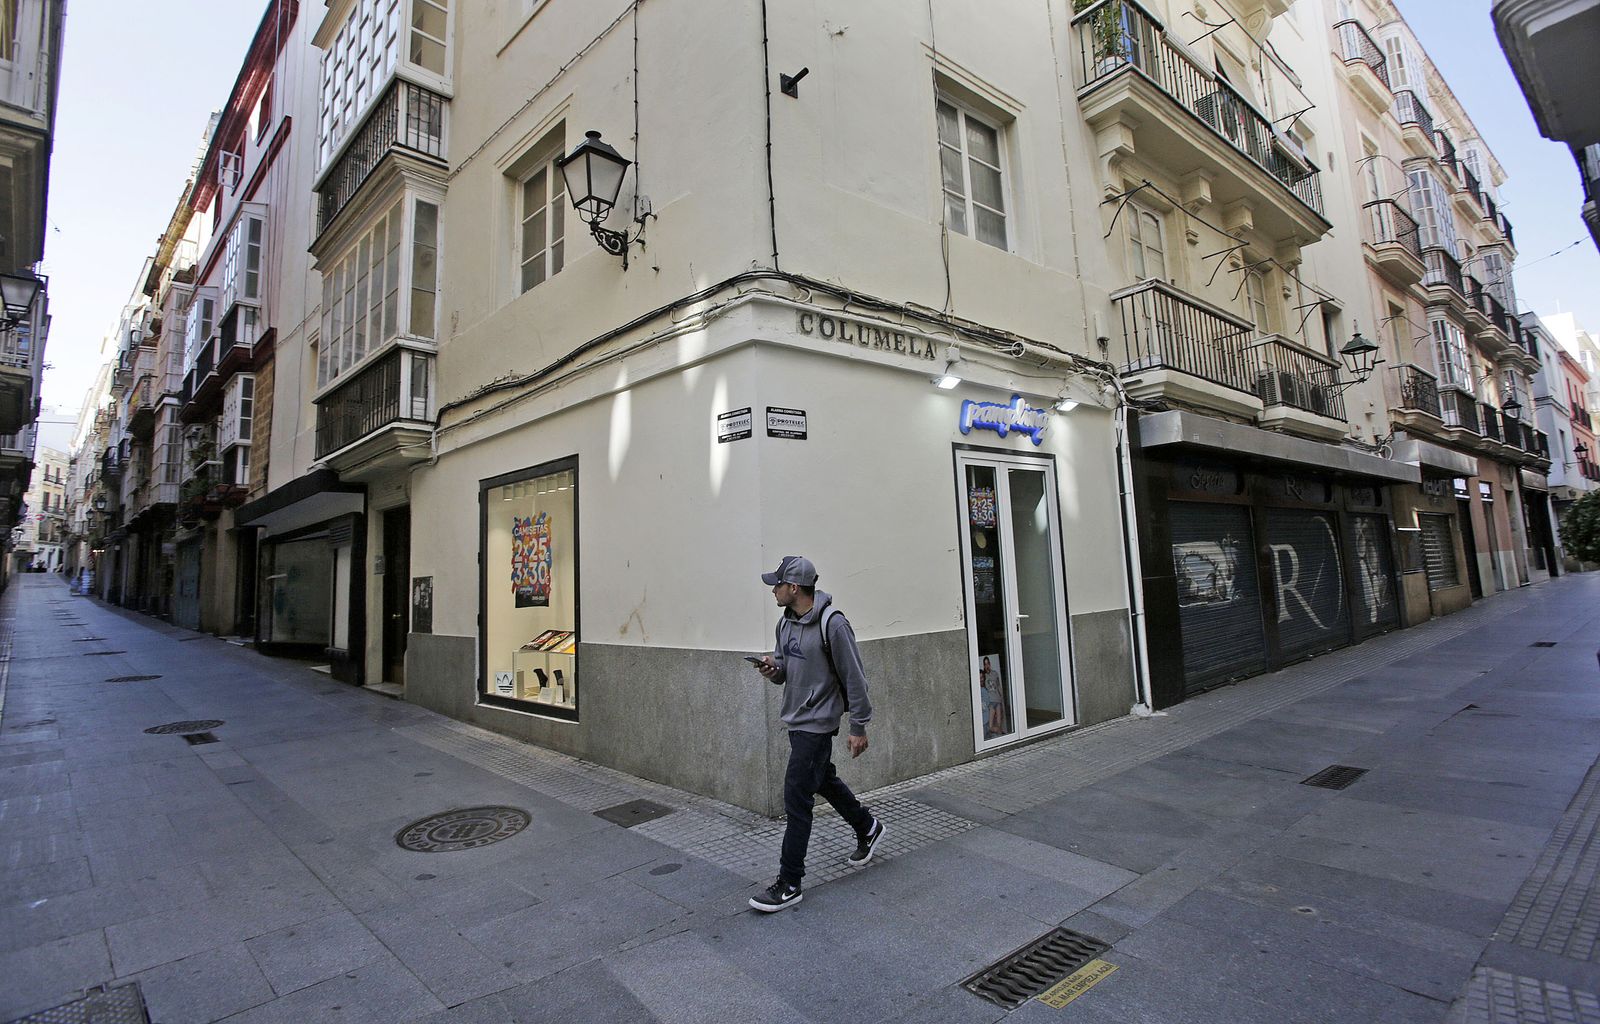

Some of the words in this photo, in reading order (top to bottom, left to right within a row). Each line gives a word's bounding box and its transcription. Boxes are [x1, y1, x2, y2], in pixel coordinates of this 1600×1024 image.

[800, 313, 936, 361] COLUMELA
[726, 419, 750, 427] PROTELEC
[960, 394, 1050, 446] pampling
[514, 524, 548, 536] CAMISETAS
[1058, 989, 1076, 1001] MAR
[1072, 973, 1100, 991] EMPIEZA
